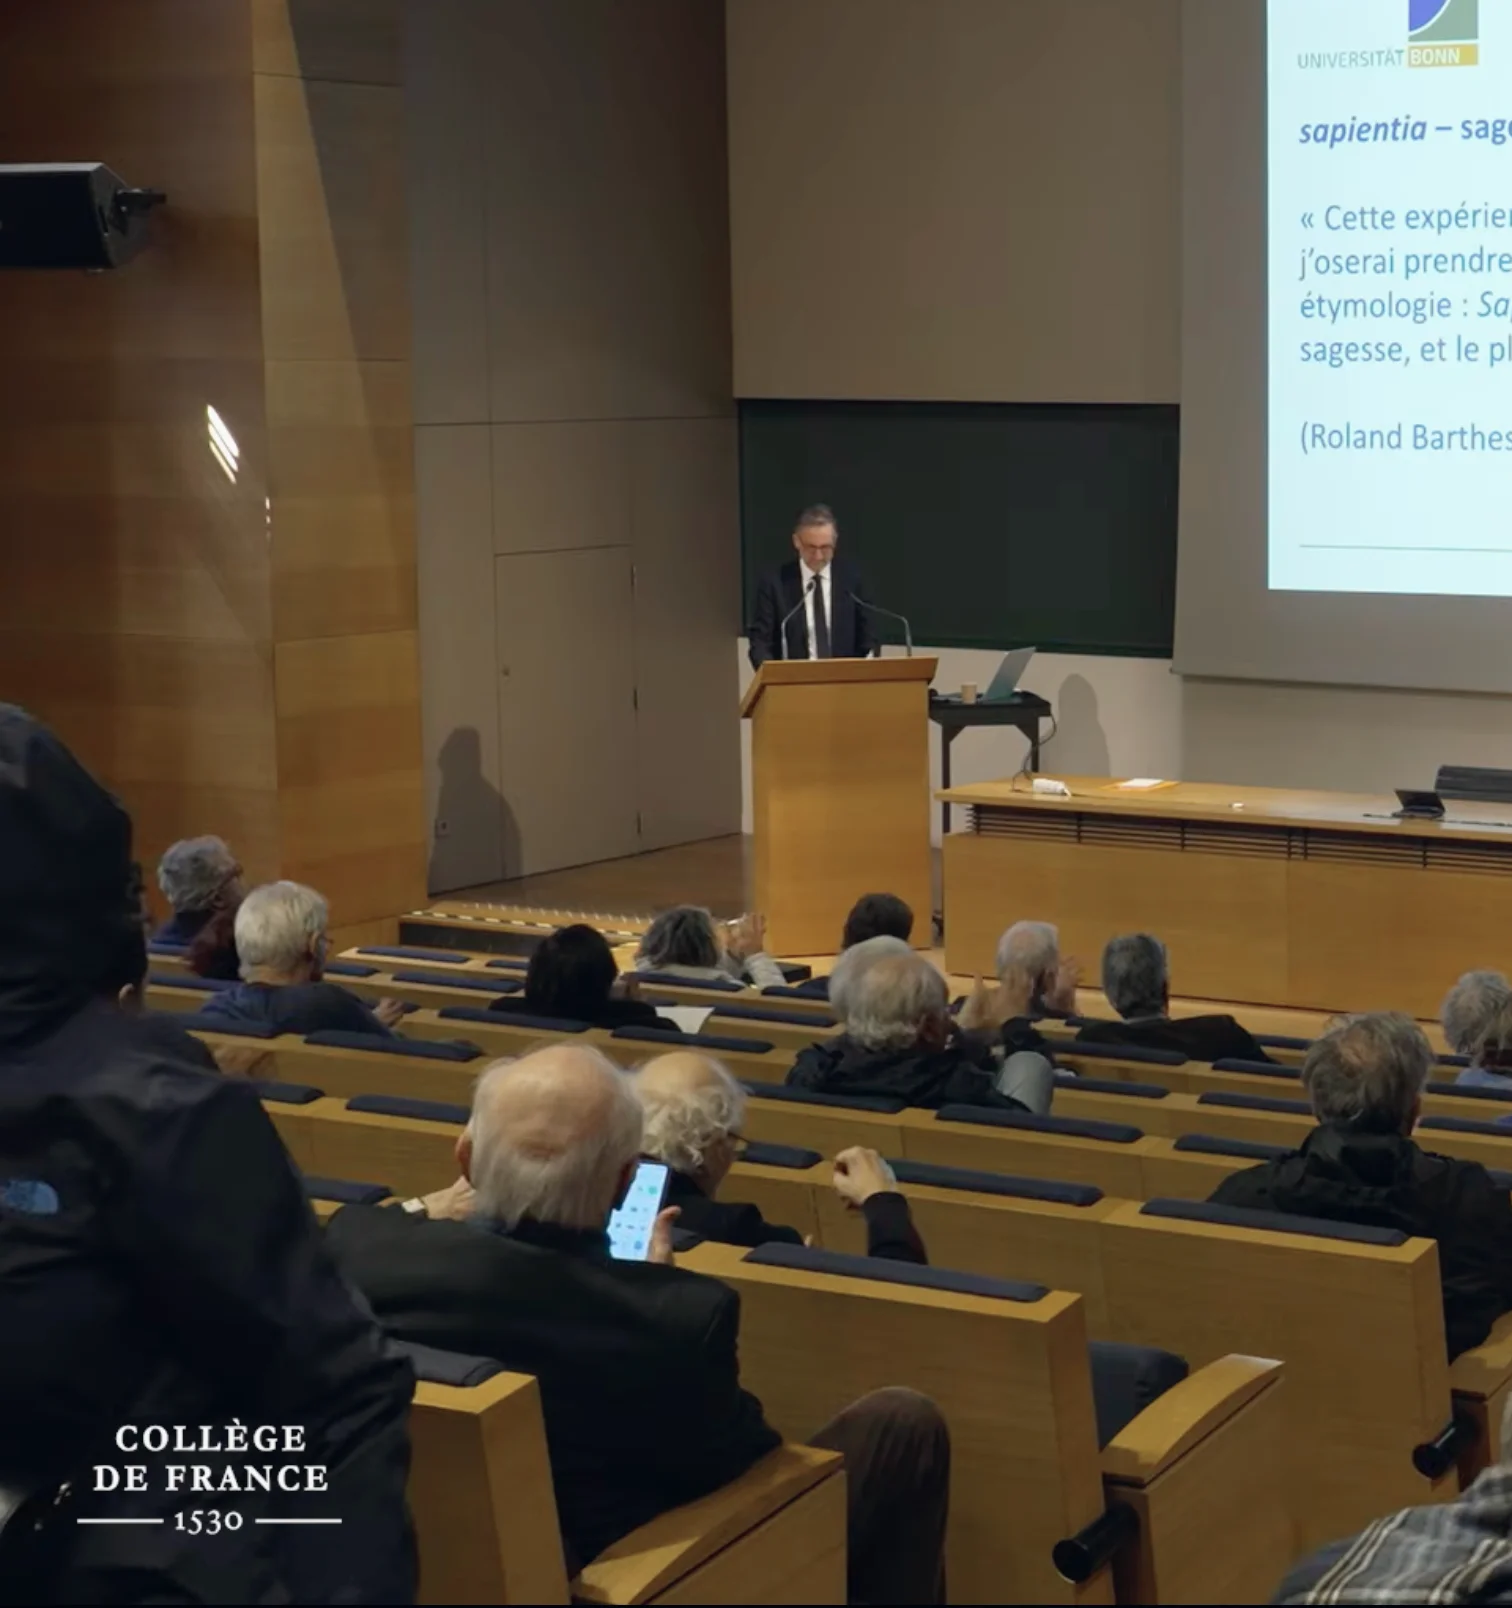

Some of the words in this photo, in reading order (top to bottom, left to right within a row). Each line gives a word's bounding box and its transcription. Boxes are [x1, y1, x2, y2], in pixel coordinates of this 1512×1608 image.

[1296, 48, 1405, 69] UNIVERSITÄT
[1410, 47, 1461, 66] BONN
[1298, 113, 1428, 150] sapientia
[1324, 204, 1396, 232] Cette
[1299, 290, 1452, 325] étymologie
[1462, 298, 1468, 318] :
[1300, 341, 1411, 369] sagesse,
[1419, 338, 1447, 363] et
[1456, 334, 1480, 363] le
[1300, 420, 1402, 456] (Roland
